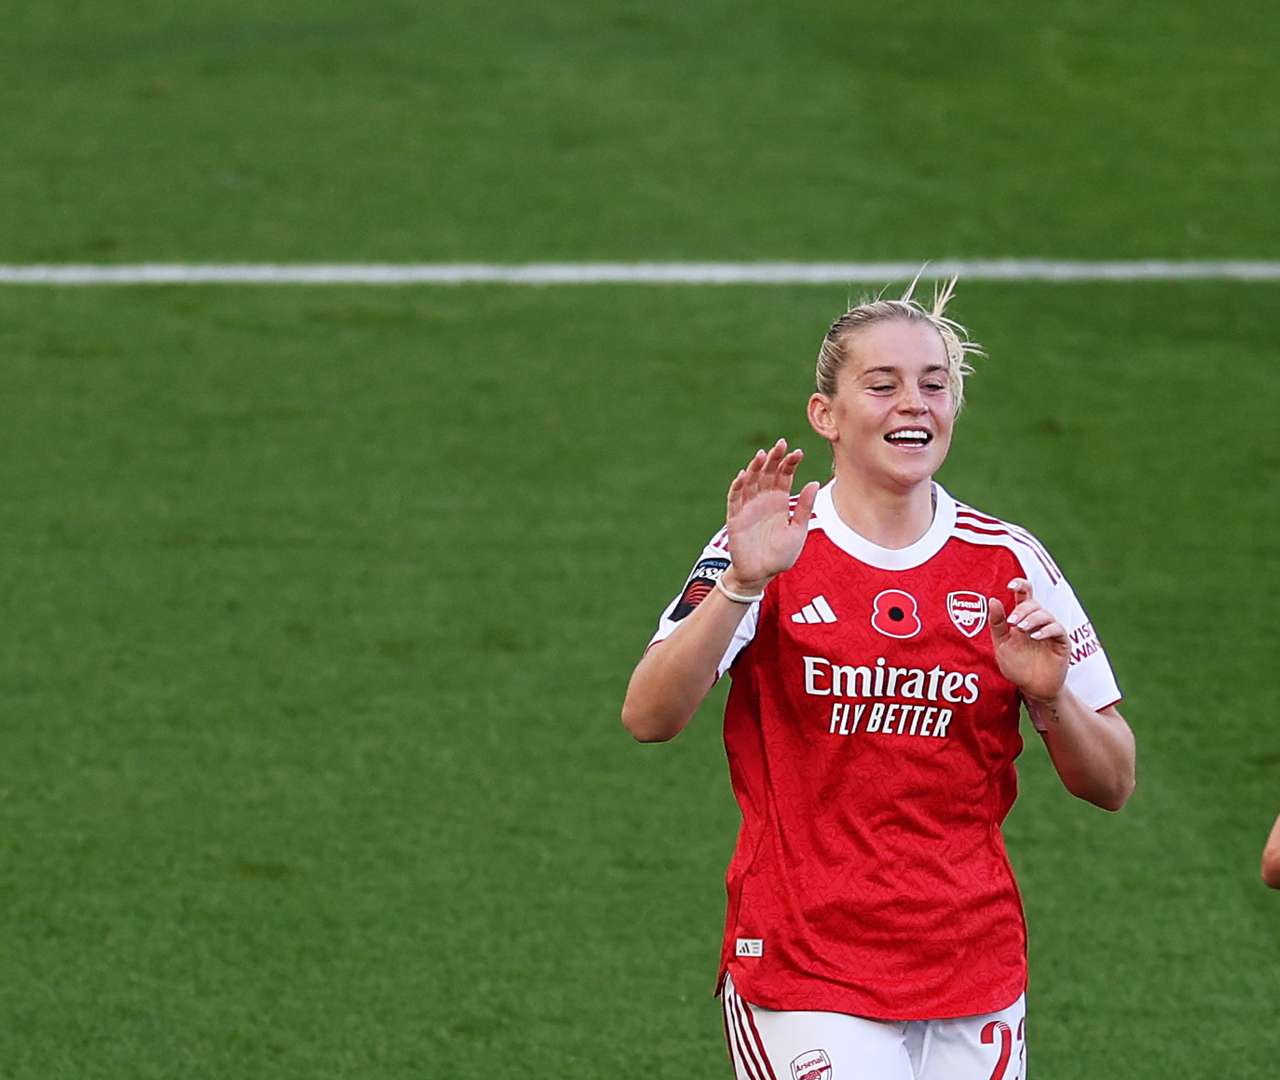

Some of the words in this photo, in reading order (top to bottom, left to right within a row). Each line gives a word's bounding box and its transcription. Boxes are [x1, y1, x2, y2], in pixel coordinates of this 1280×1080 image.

[952, 598, 982, 609] Arsenal
[1069, 621, 1091, 644] VIS
[802, 656, 980, 705] Emirates
[829, 702, 867, 736] FLY
[866, 702, 953, 738] BETTER
[795, 1055, 825, 1072] Arsenal
